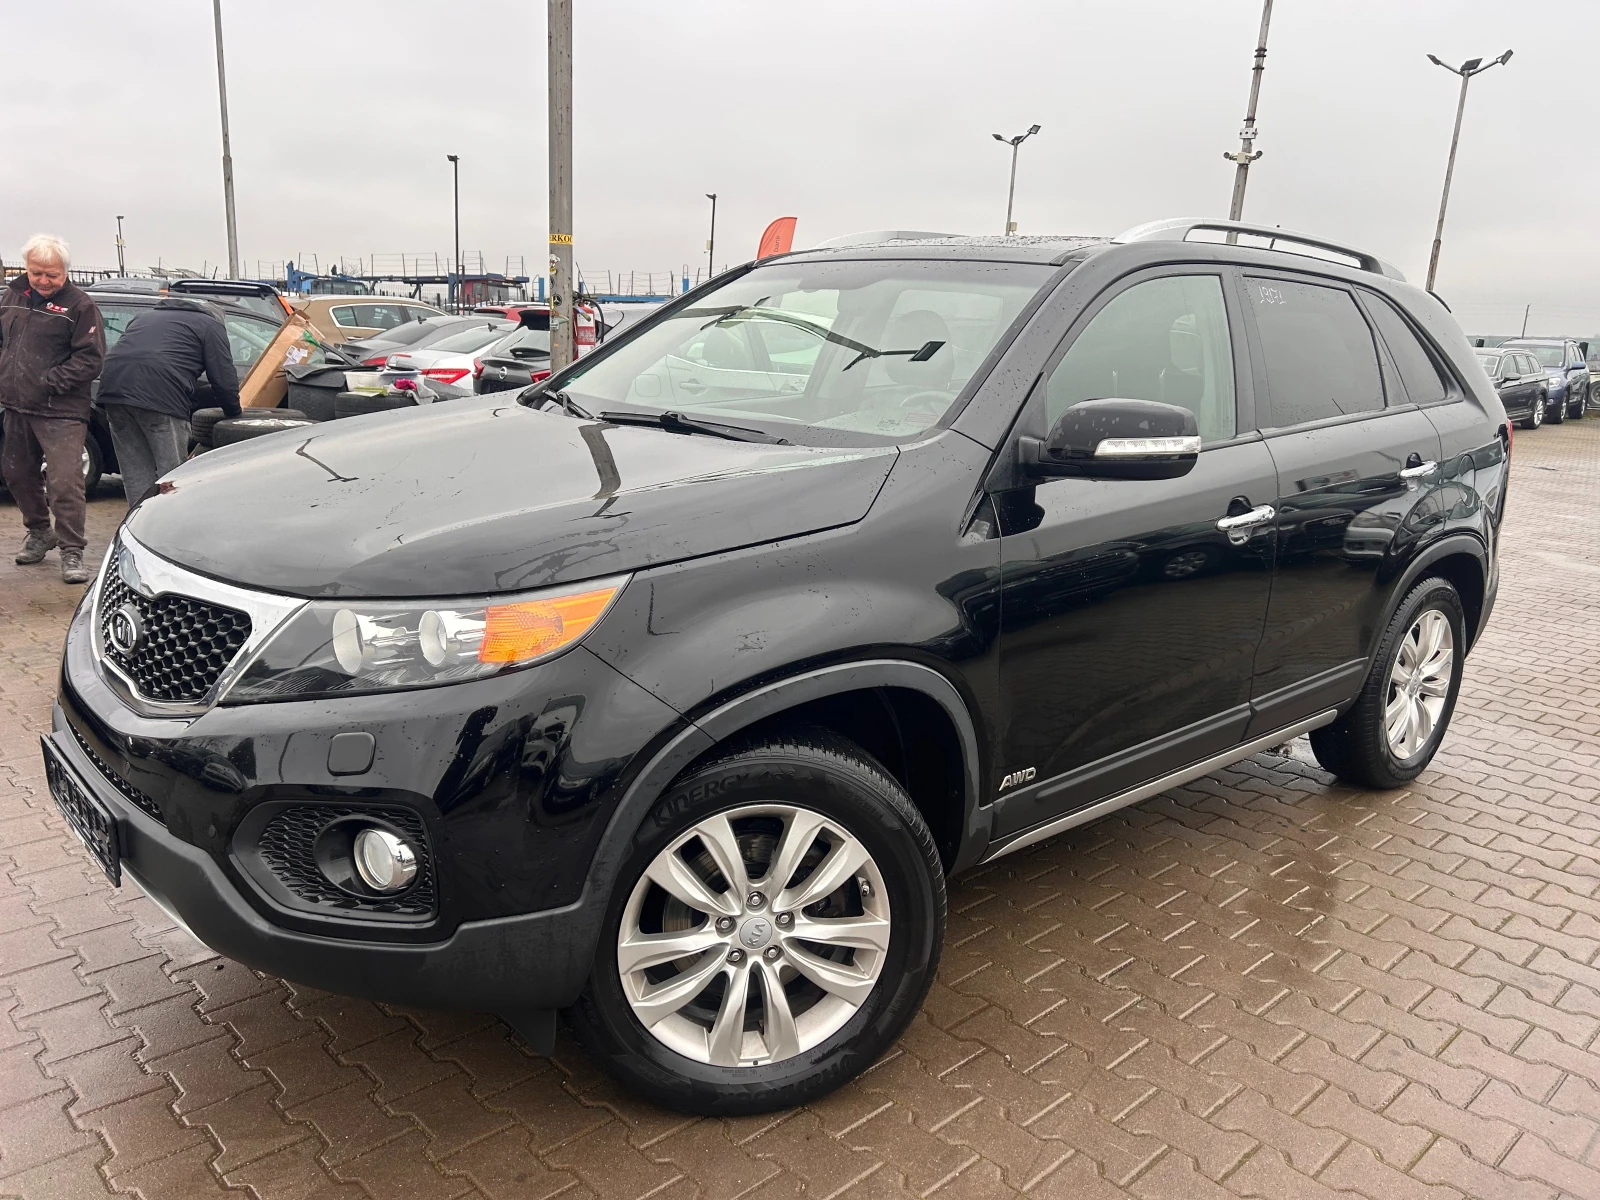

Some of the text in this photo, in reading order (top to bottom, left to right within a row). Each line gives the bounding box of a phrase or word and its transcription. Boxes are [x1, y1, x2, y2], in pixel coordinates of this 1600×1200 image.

[773, 235, 781, 253] bank
[998, 766, 1037, 791] AWD
[651, 771, 750, 828] KINERGY
[746, 922, 767, 947] KIA
